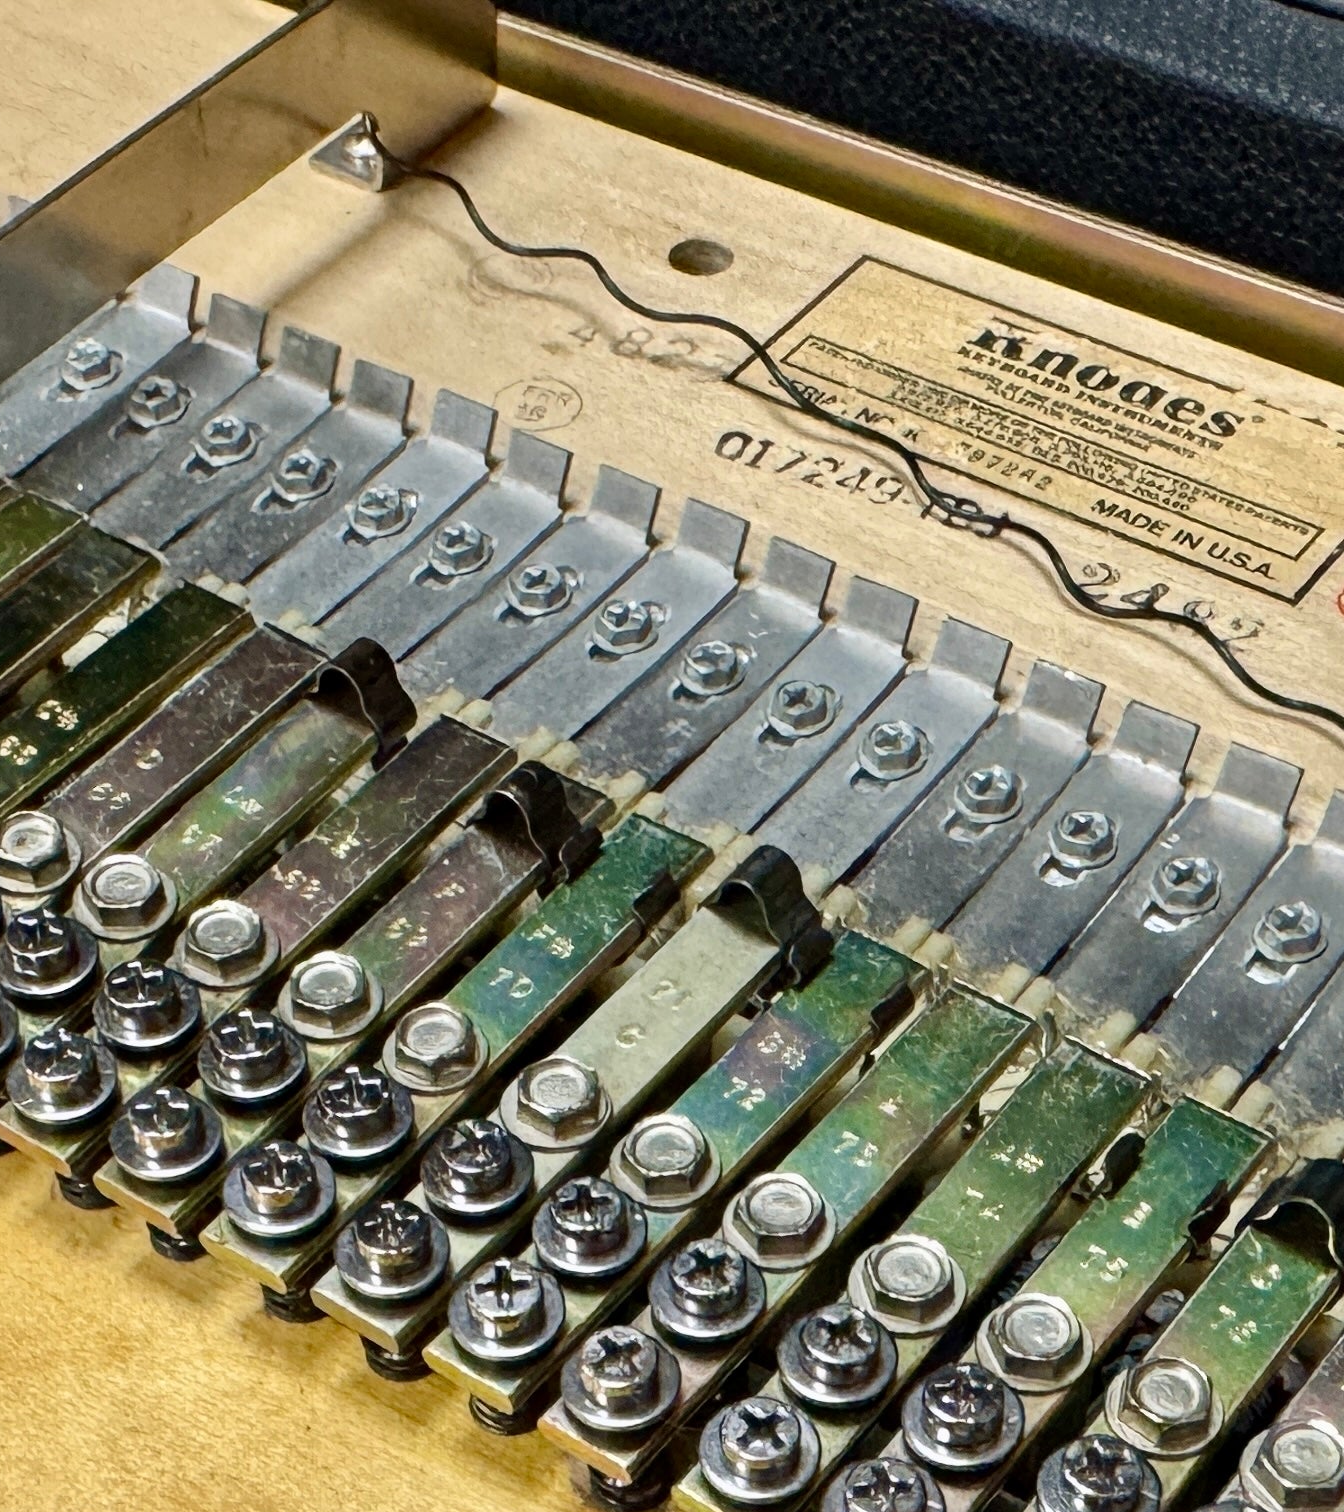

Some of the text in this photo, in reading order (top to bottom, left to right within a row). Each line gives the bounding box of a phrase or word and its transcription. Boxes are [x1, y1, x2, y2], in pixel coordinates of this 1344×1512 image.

[1075, 390, 1224, 451] INSTRUMENTS
[1091, 498, 1171, 538] MADE
[1172, 528, 1205, 552] IN
[723, 1075, 768, 1112] 72
[1079, 1243, 1130, 1283] 75
